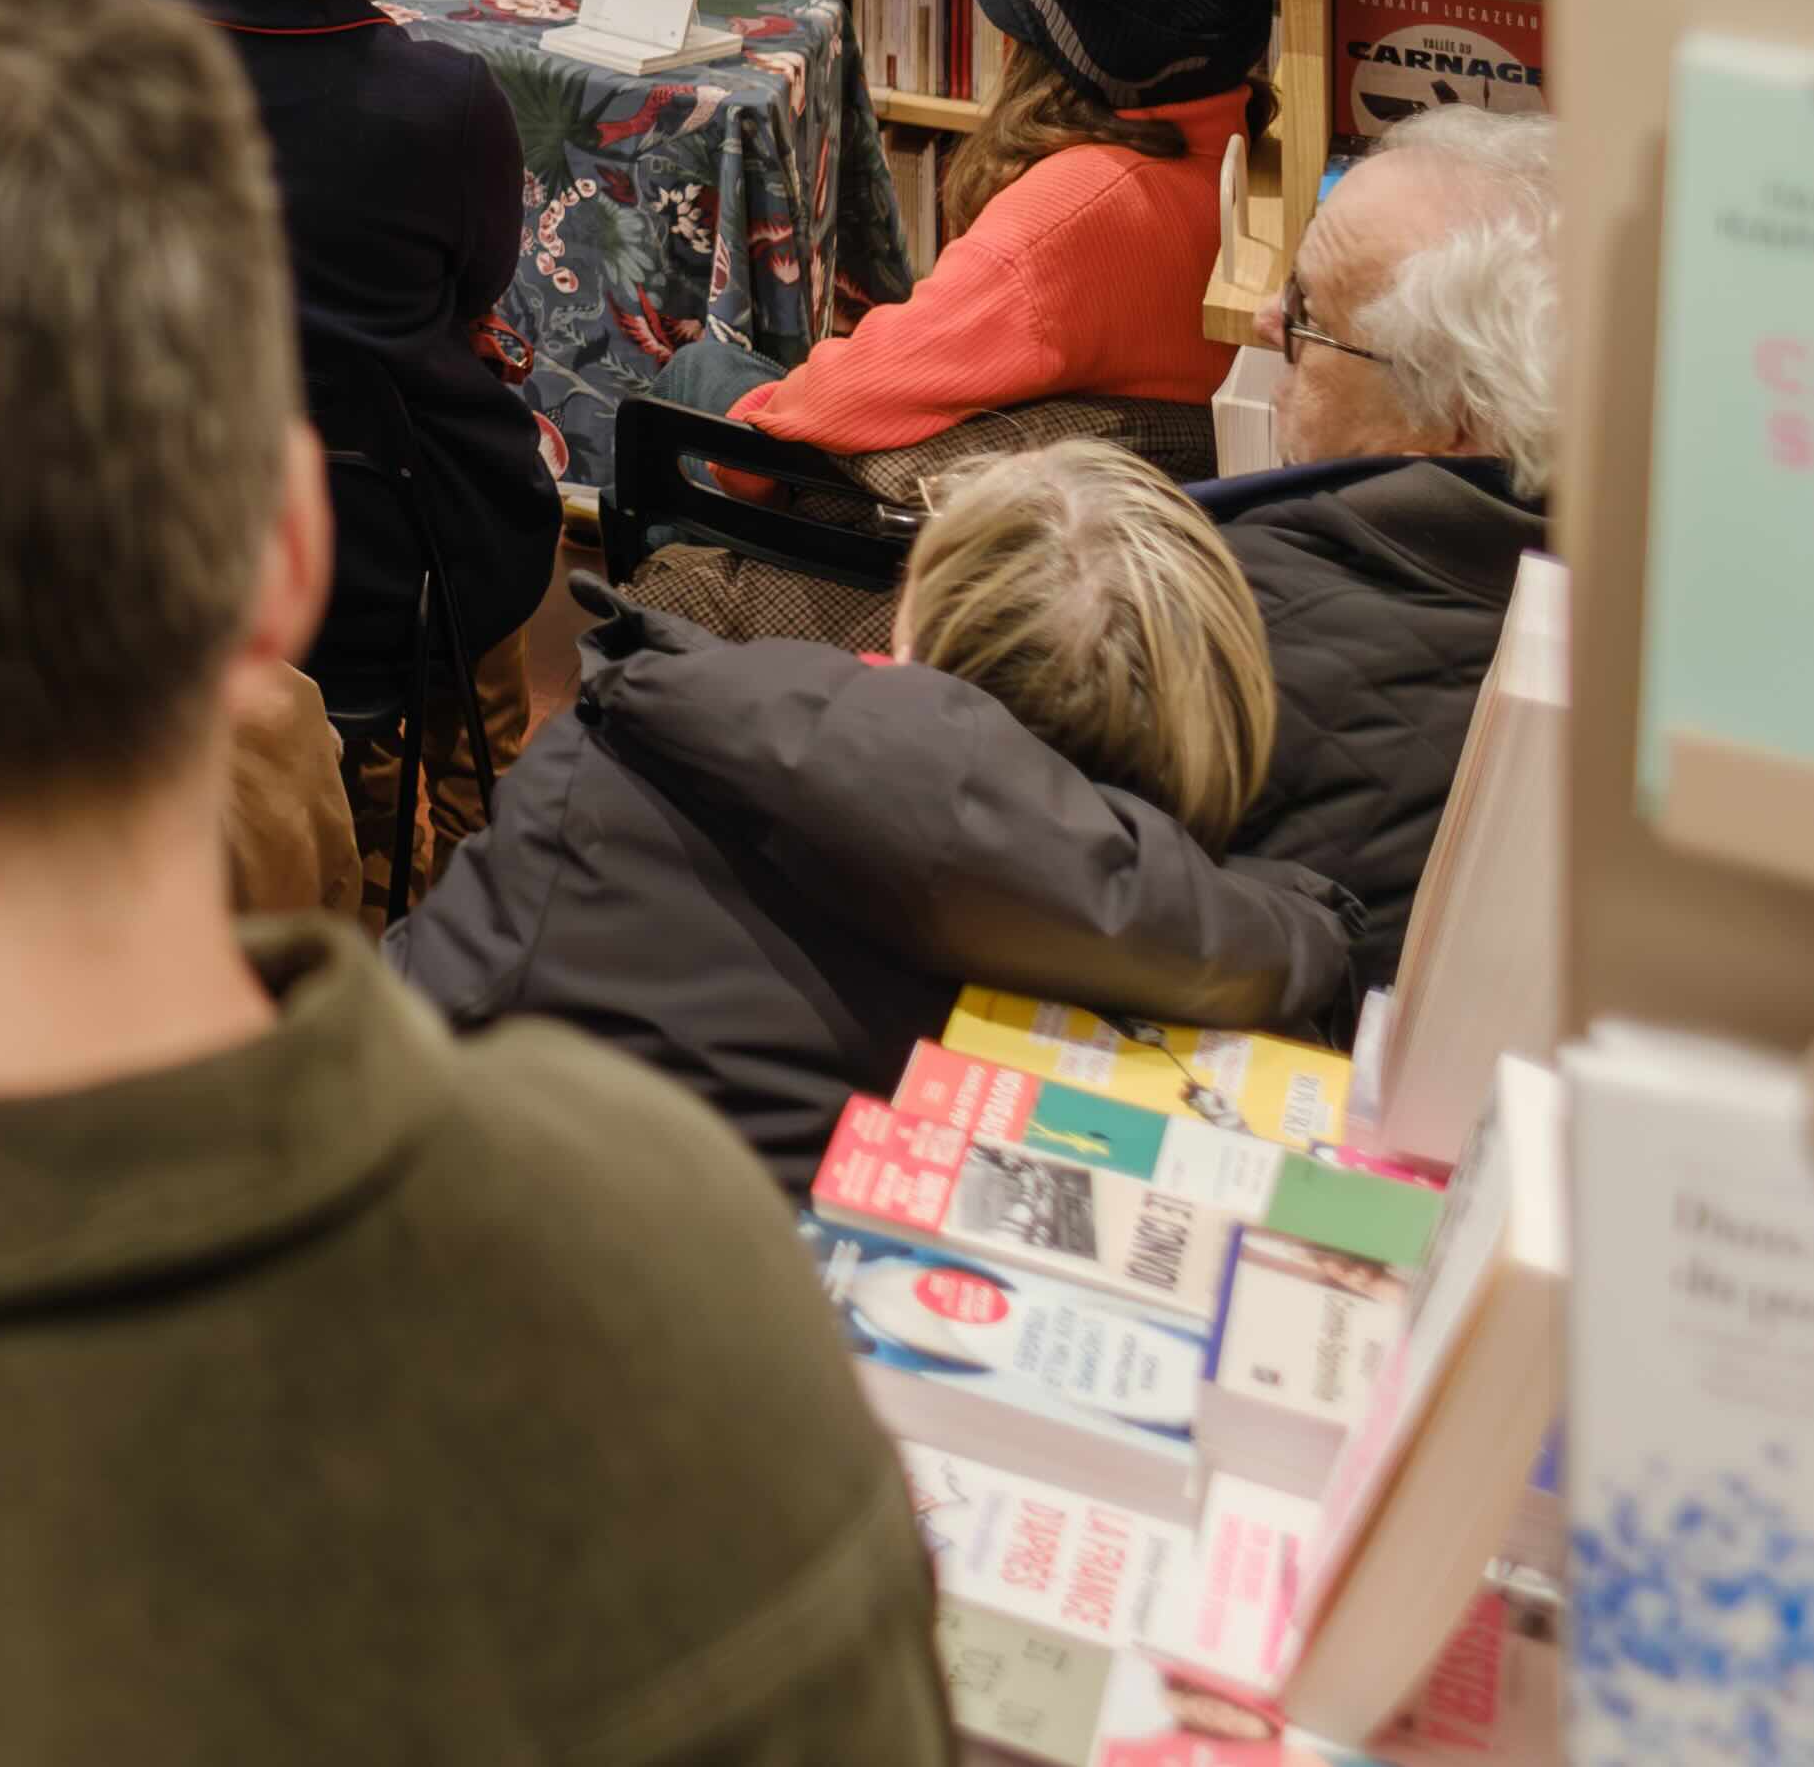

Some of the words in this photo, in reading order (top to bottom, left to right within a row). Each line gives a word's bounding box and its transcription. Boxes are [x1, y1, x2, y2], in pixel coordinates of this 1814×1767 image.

[1444, 3, 1539, 30] LUCAZEAU
[1347, 41, 1542, 86] CARNAGE
[1422, 36, 1455, 53] VALLÉE
[1458, 42, 1472, 54] DU
[1145, 1191, 1195, 1222] LE
[1125, 1218, 1190, 1293] CONVOI
[1087, 1504, 1134, 1539] LA
[1000, 1497, 1068, 1593] D'APRÈS
[1060, 1536, 1127, 1632] FRANCE
